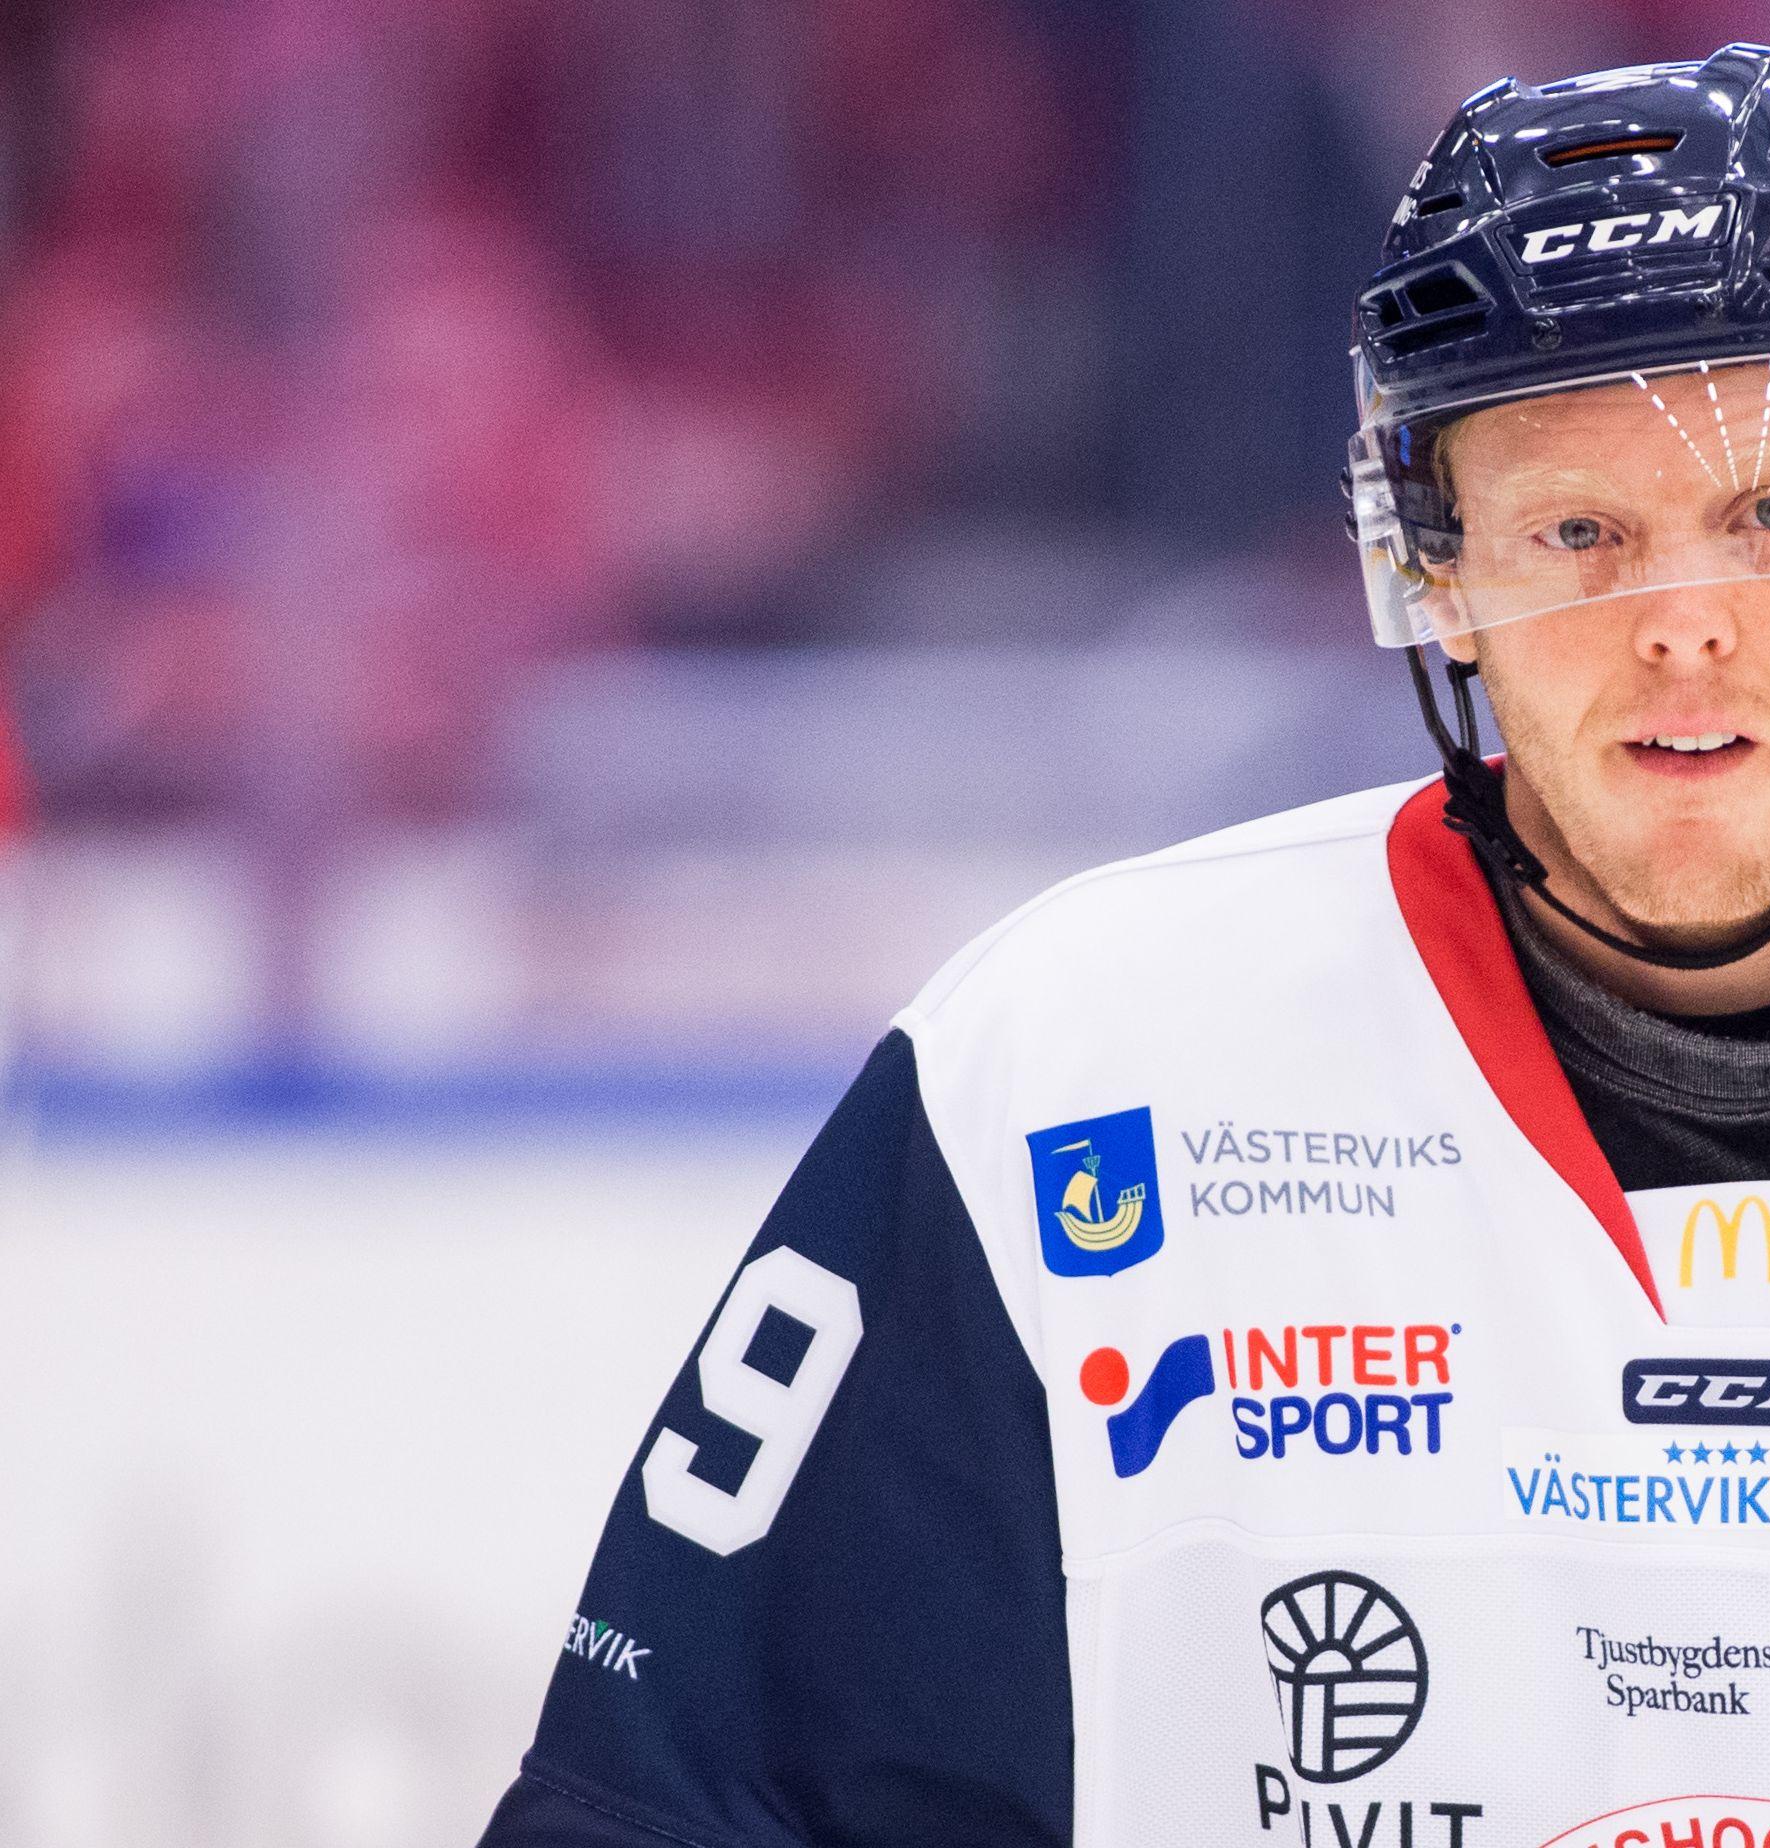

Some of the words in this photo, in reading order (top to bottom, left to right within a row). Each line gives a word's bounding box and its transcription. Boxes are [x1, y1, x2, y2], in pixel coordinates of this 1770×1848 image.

[1521, 204, 1722, 264] CCM
[1181, 1121, 1463, 1169] VÄSTERVIKS
[1188, 1180, 1396, 1218] KOMMUN
[641, 1244, 864, 1557] 9
[1232, 1391, 1454, 1460] SPORT
[564, 1613, 653, 1680] ERVIK
[1605, 1673, 1751, 1717] Sparbank
[1255, 1763, 1483, 1848] PIVIT
